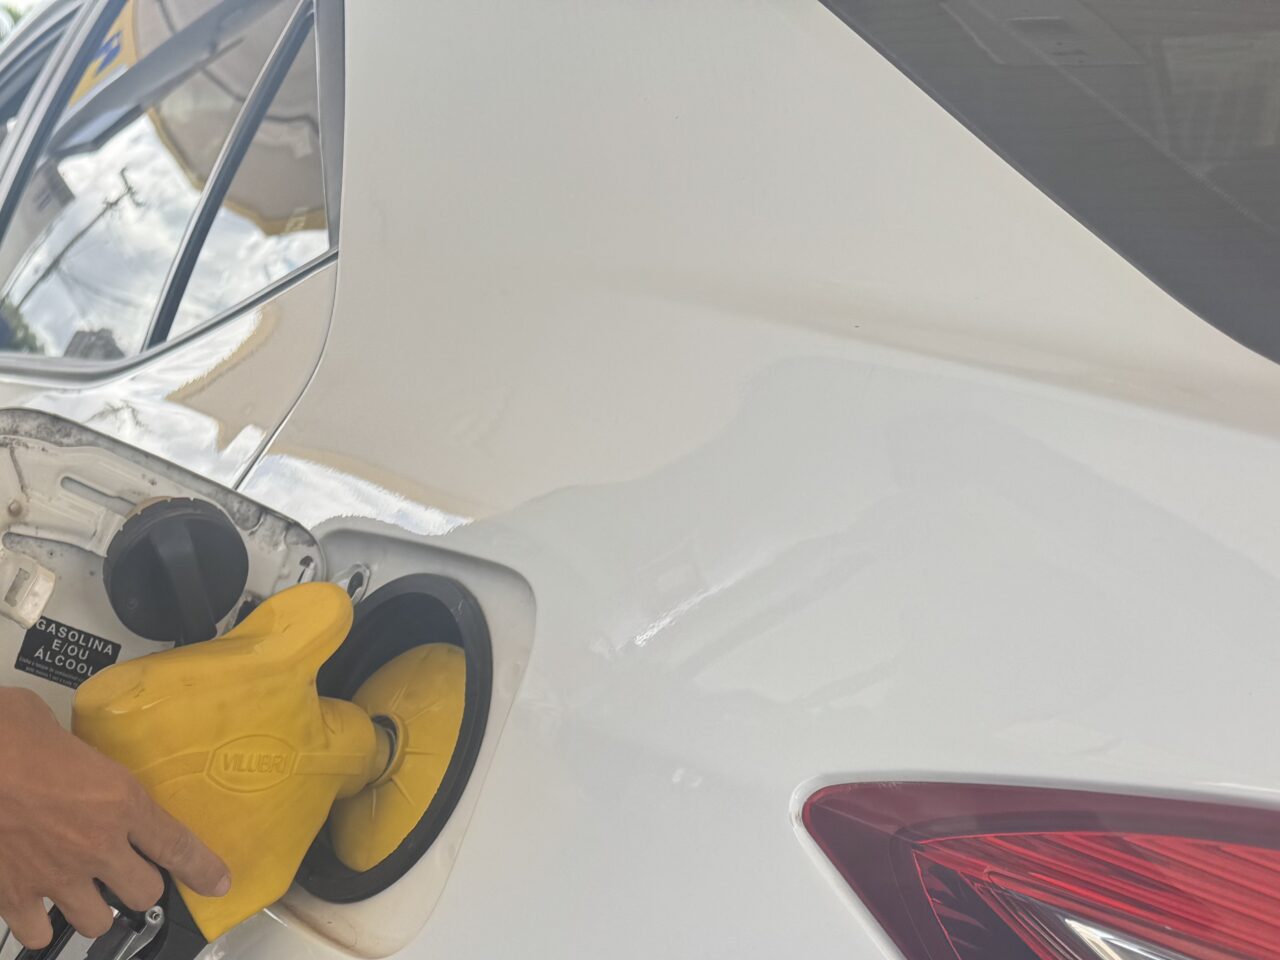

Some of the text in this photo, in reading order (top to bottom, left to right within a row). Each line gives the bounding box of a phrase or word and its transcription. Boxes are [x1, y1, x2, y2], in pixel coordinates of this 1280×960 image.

[35, 618, 113, 656] GASOLINA
[52, 639, 89, 660] E/OU
[33, 645, 94, 676] ÁLCOOL
